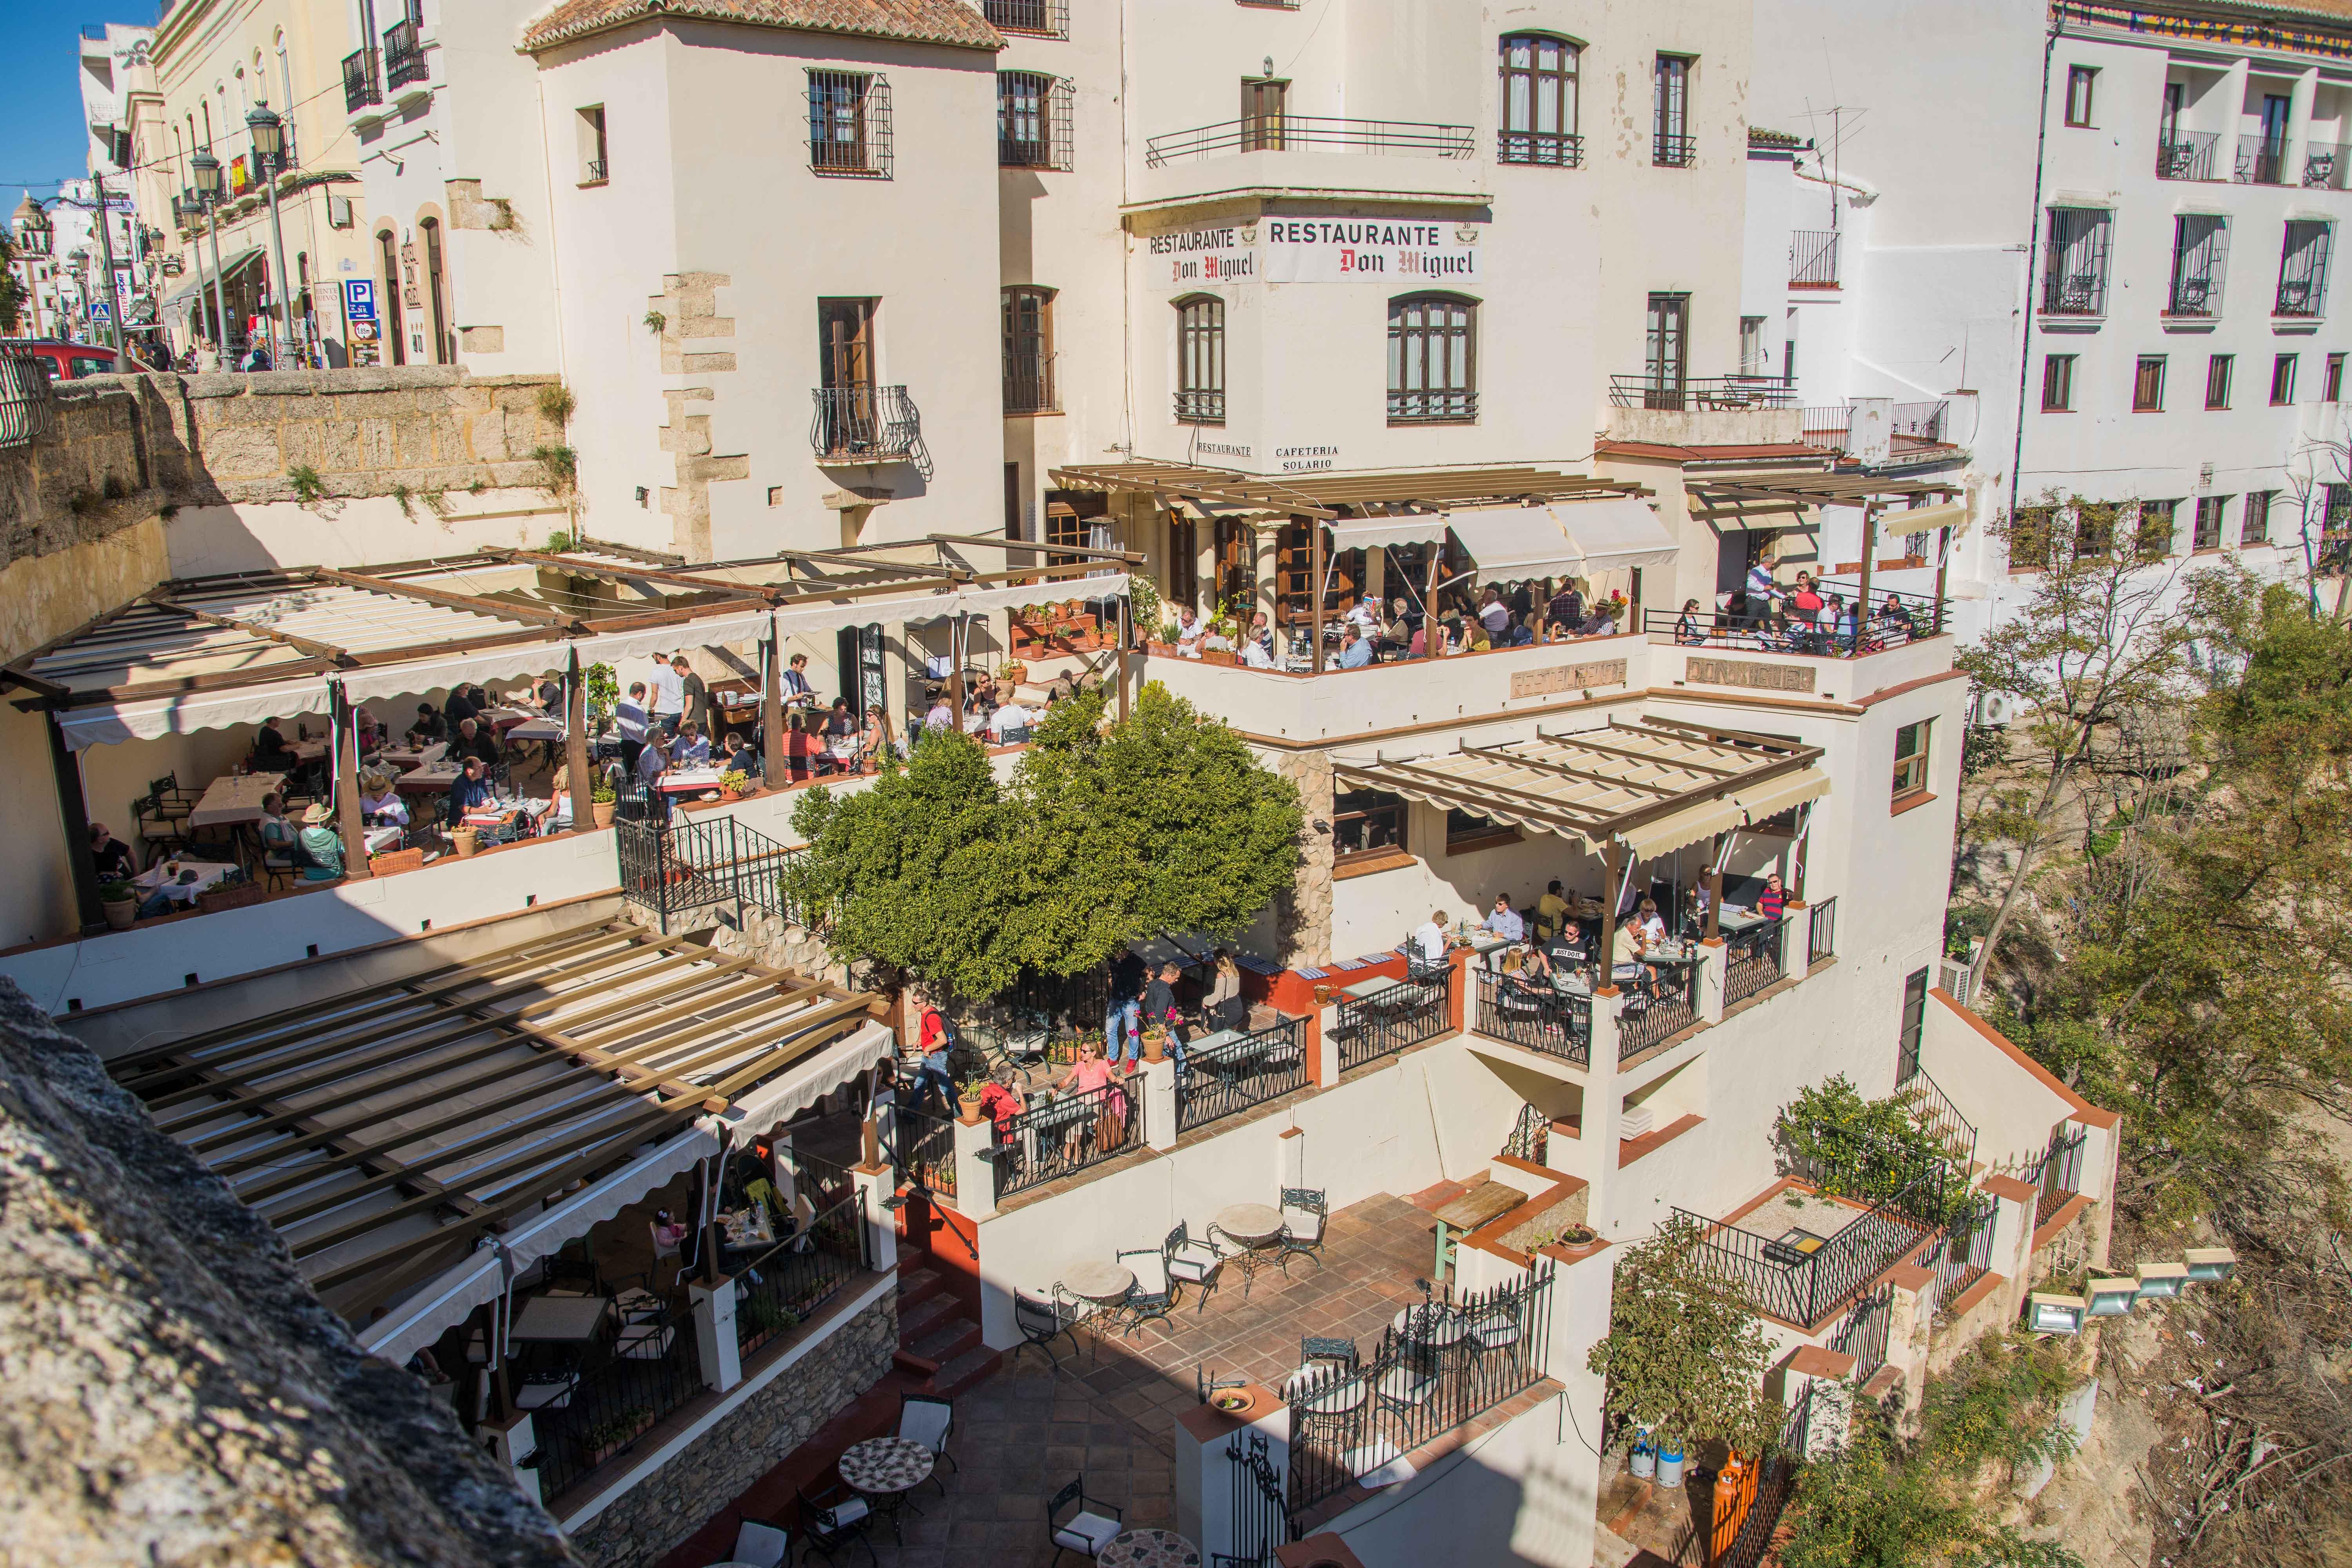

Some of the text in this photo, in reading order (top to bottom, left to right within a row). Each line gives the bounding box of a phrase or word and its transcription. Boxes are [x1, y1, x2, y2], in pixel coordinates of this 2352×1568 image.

[2154, 16, 2233, 42] HOTEL
[1151, 229, 1234, 254] RESTAURANTE
[1271, 223, 1439, 246] RESTAURANTE
[401, 243, 416, 263] HOTEL
[1340, 249, 1474, 279] Don Miguel
[405, 266, 416, 284] DON
[1173, 251, 1253, 285] Don Miguel
[118, 272, 129, 315] INTERSPORT
[353, 285, 367, 301] P
[404, 287, 421, 306] MIGUEL
[1198, 443, 1251, 456] RESTAURANTE
[1276, 446, 1338, 457] CAFETERIA
[1283, 460, 1331, 470] SOLARIO
[1512, 661, 1626, 697] RESTAURANTE
[1734, 664, 1811, 691] MIGUEL
